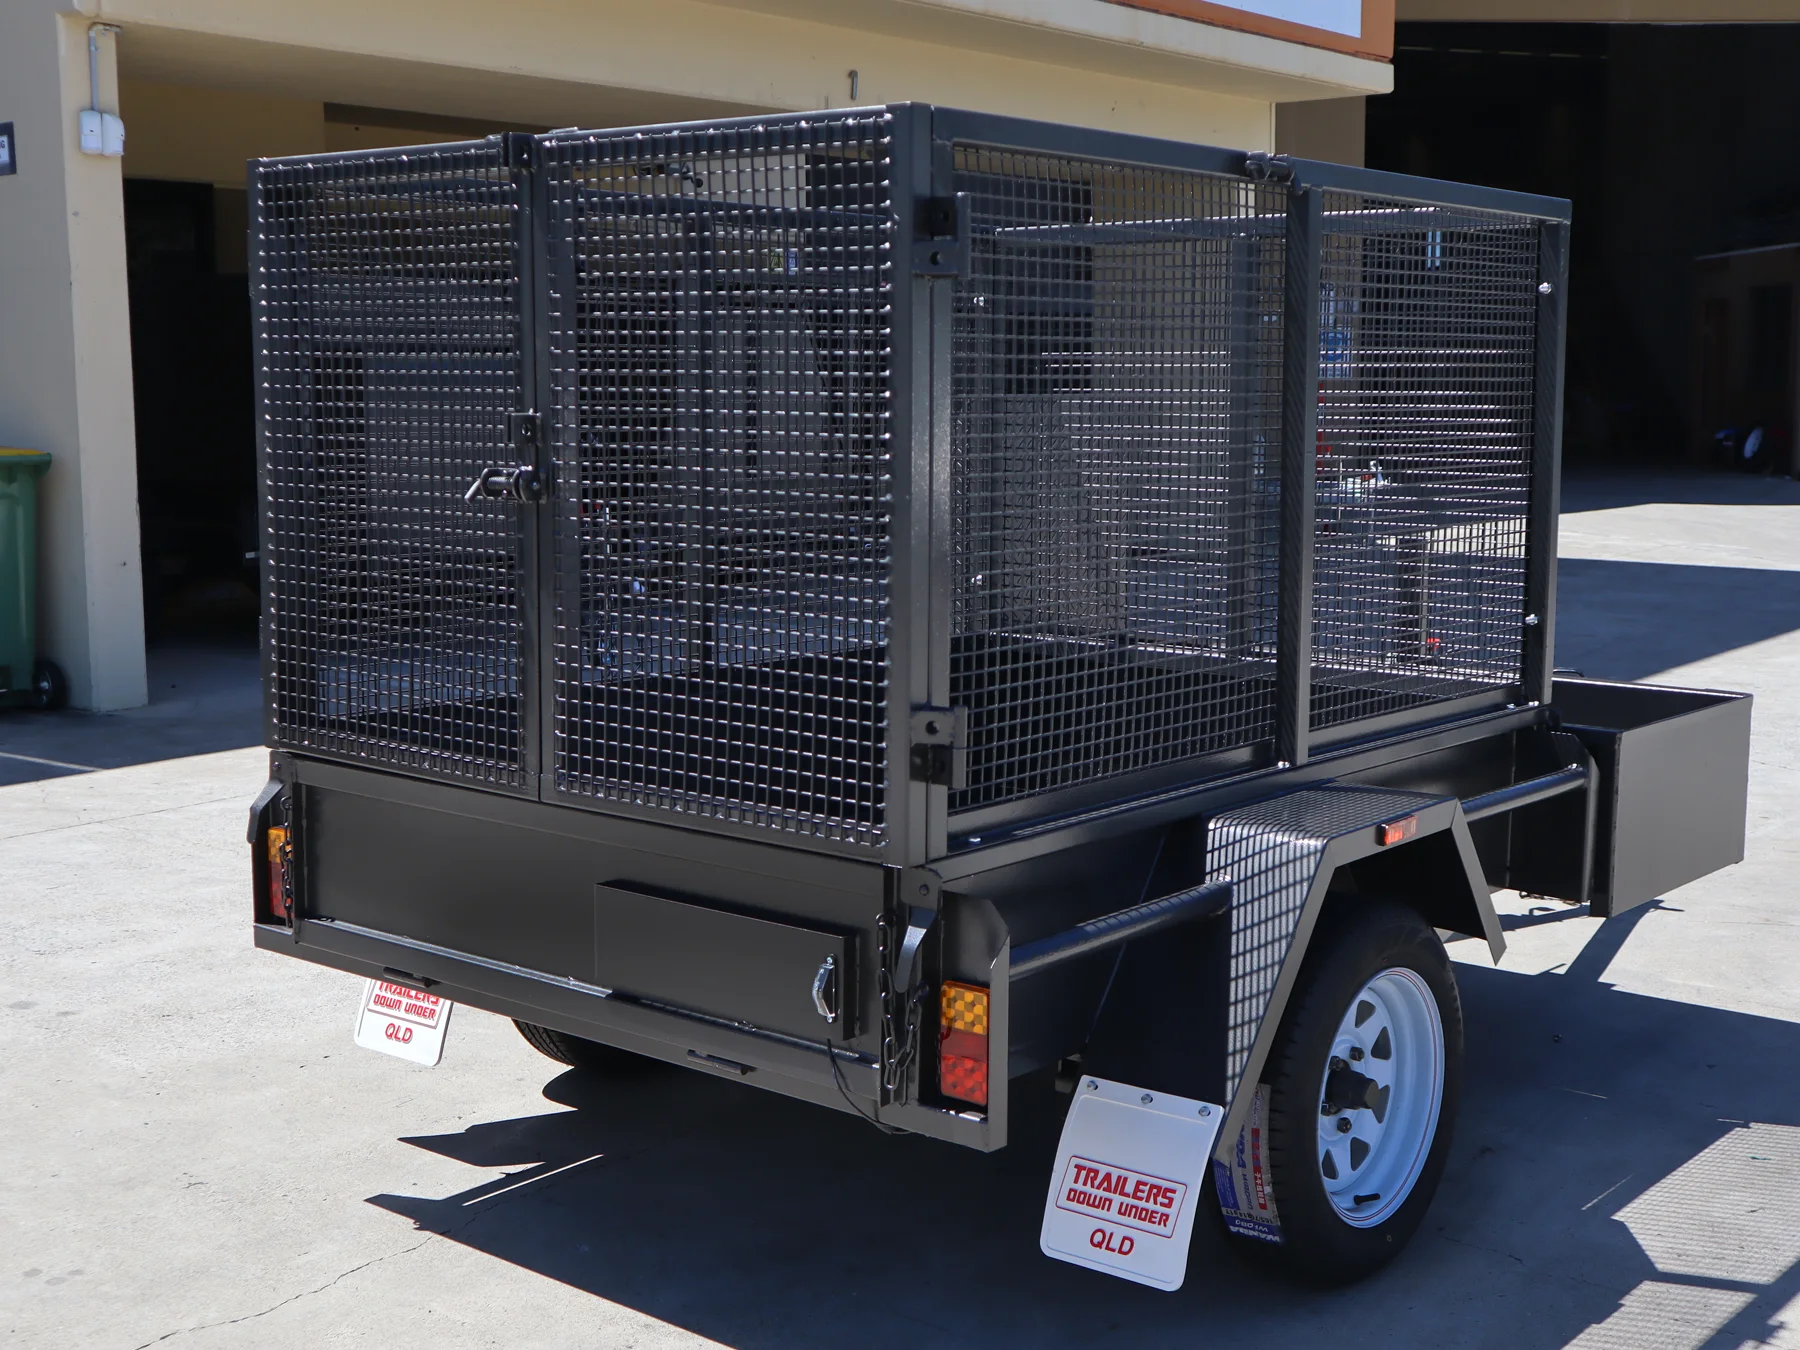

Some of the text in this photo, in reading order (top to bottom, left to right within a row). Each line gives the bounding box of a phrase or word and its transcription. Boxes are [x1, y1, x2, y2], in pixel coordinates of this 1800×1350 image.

[374, 994, 436, 1019] DOWN UNDER
[385, 1023, 413, 1044] QLD
[1073, 1164, 1177, 1209] TRAILERS
[1066, 1188, 1171, 1228] DOWN UNDER
[1089, 1228, 1135, 1256] QLD
